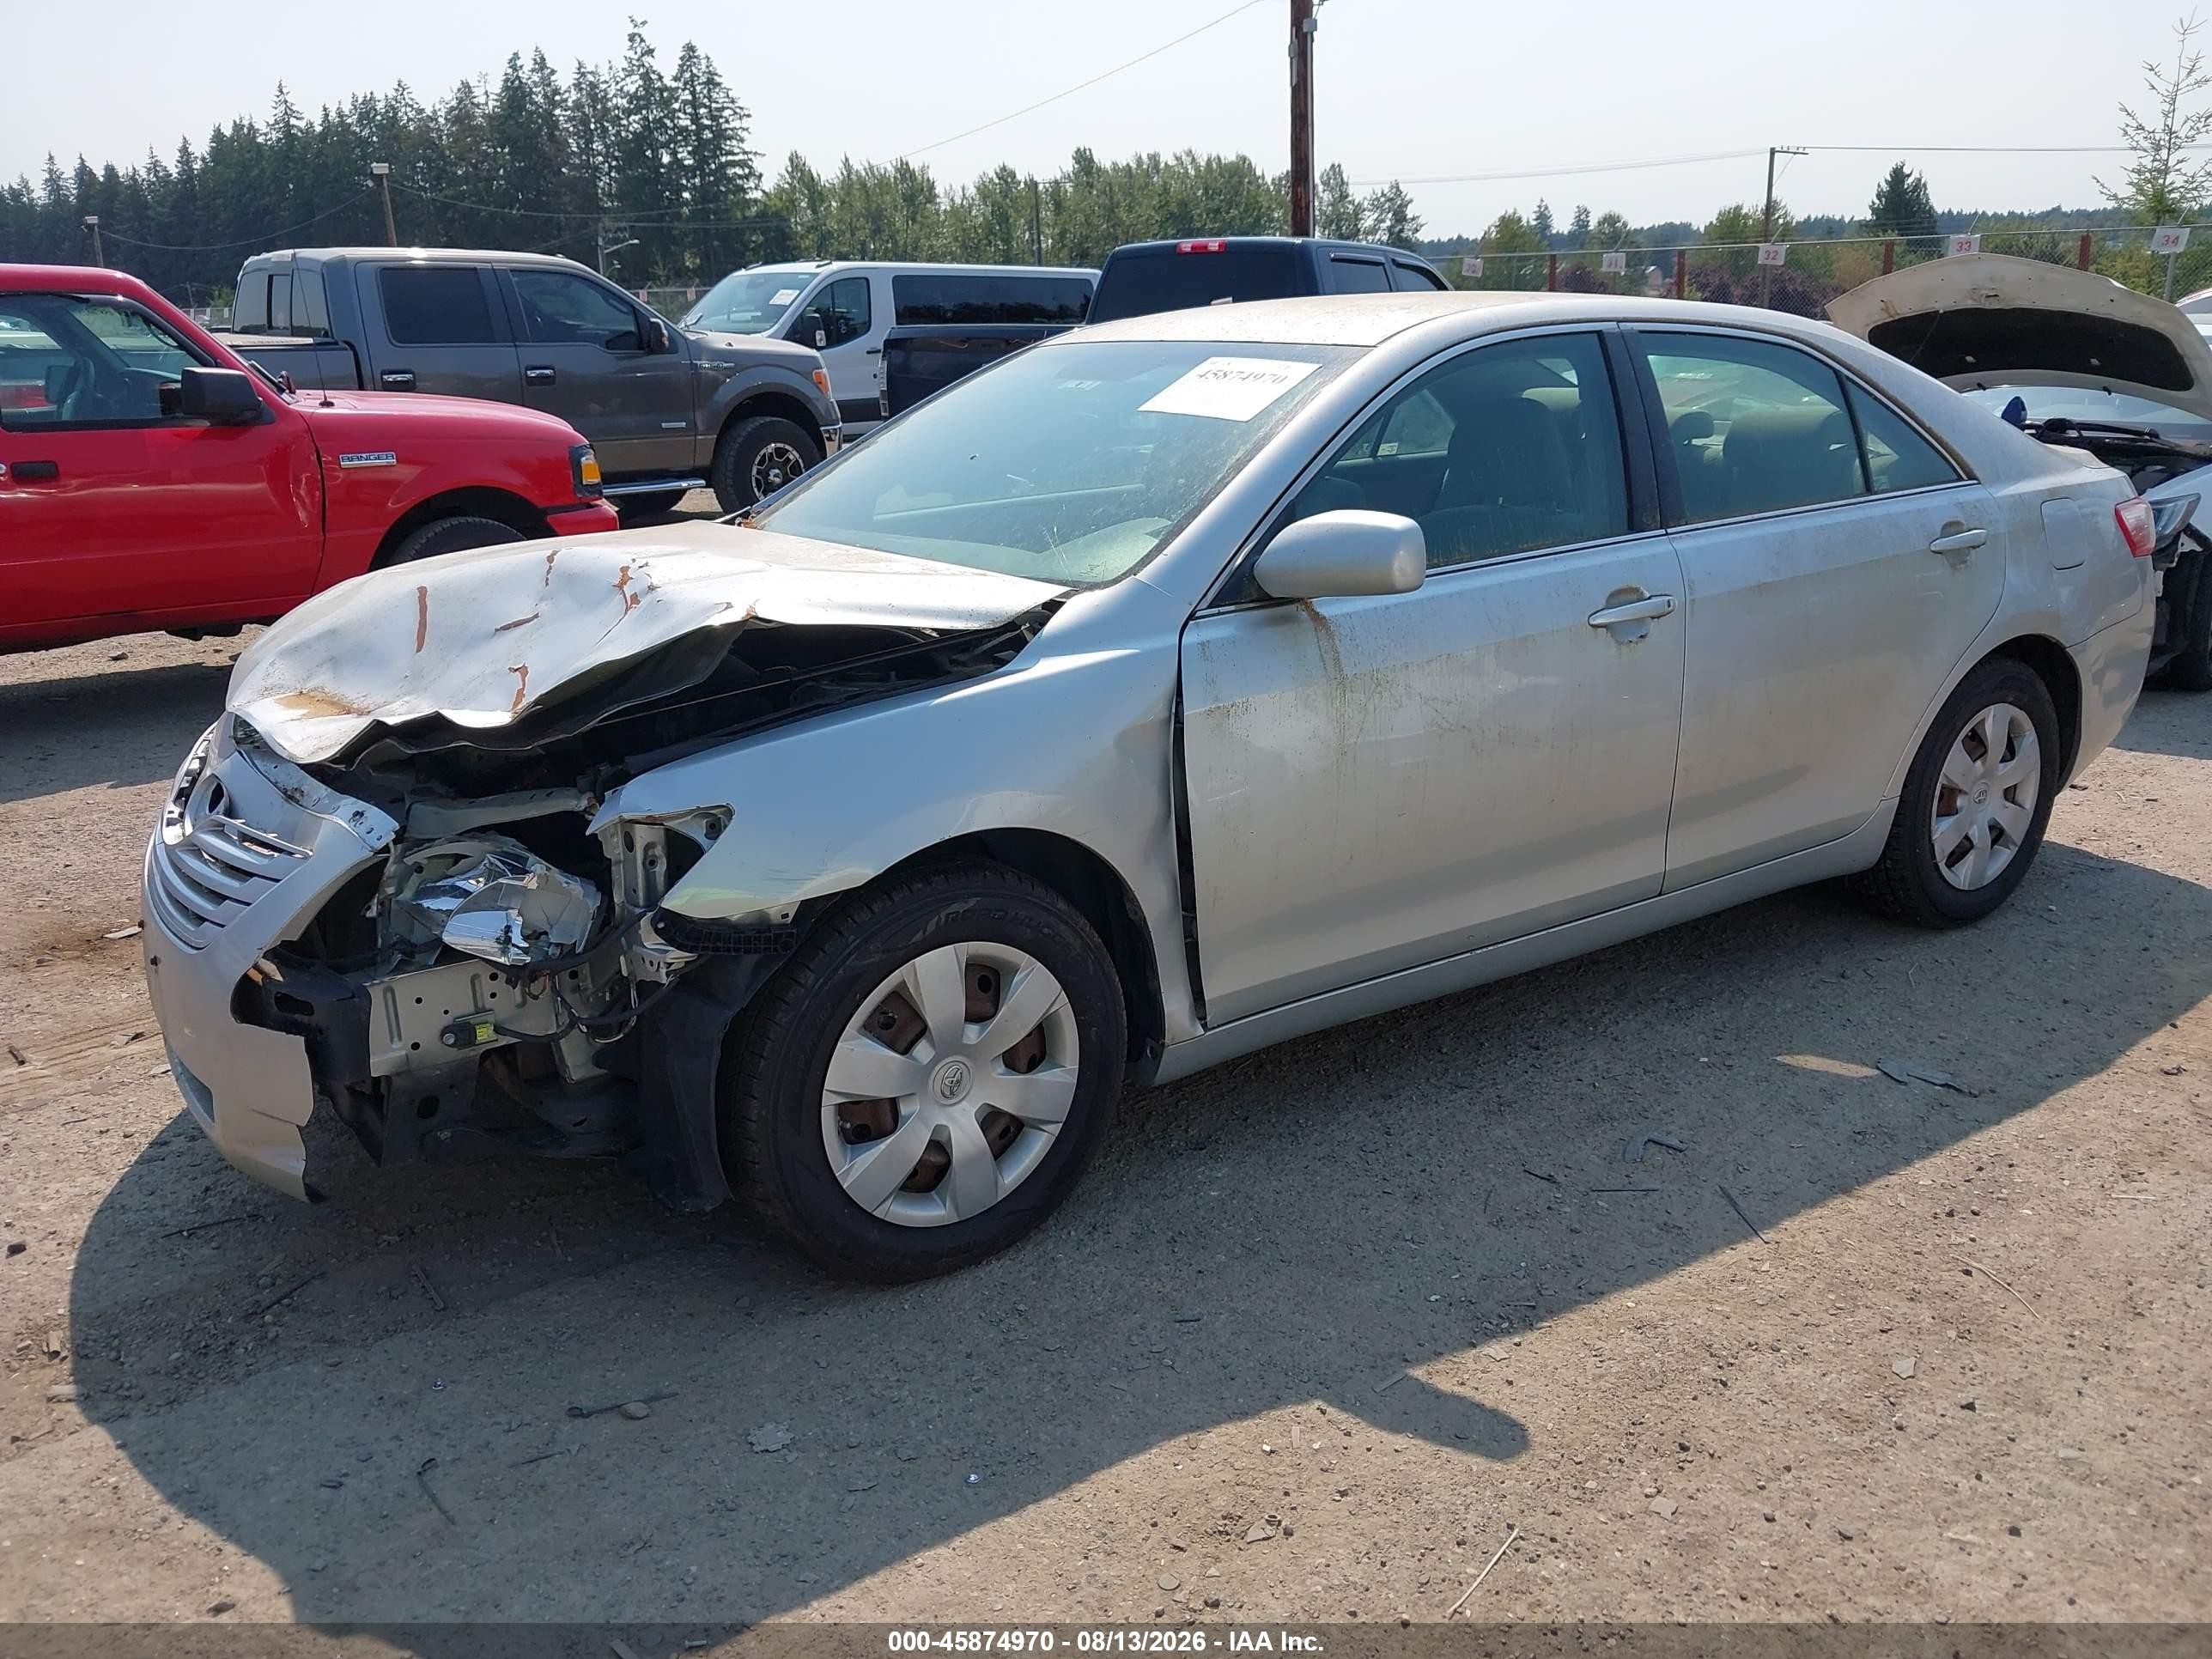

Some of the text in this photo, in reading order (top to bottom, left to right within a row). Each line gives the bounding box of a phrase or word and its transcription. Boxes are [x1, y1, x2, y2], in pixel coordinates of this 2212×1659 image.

[1956, 241, 1972, 252] 33
[2160, 235, 2179, 247] 34
[1765, 249, 1779, 261] 32
[1196, 369, 1289, 385] 45874970
[341, 453, 395, 463] RANGER
